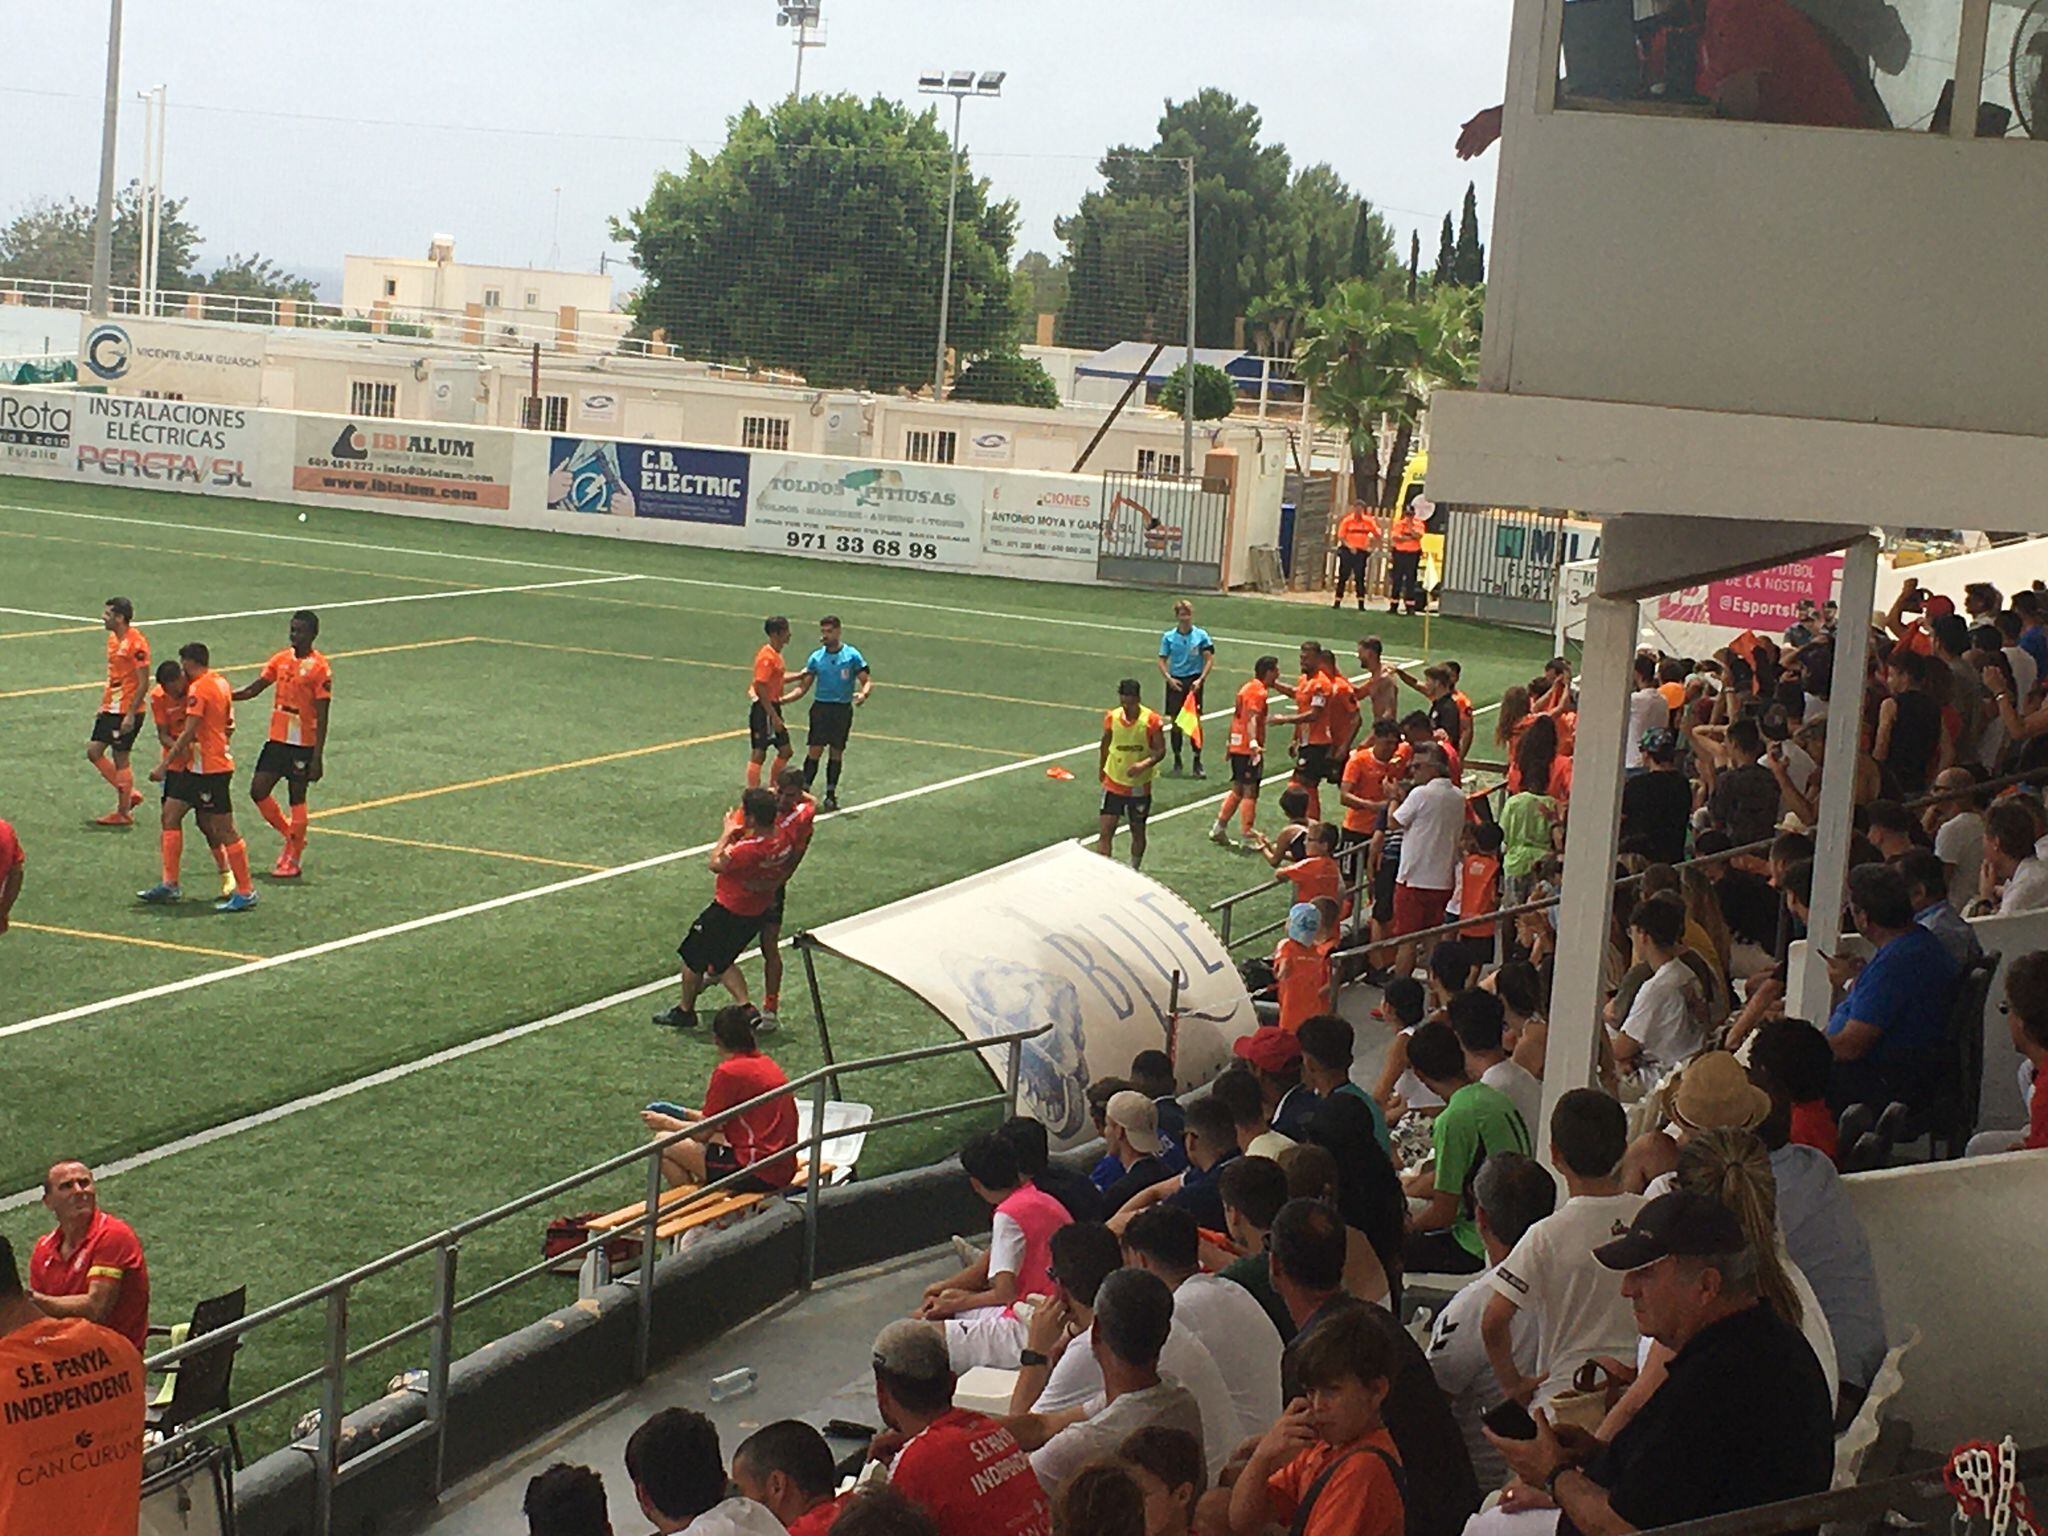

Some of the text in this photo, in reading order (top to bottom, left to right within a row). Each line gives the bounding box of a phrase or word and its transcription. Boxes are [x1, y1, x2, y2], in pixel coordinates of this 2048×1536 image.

[137, 347, 181, 361] VICENTE
[183, 351, 213, 364] JUAN
[215, 354, 260, 368] GUASCH
[1, 397, 71, 432] Rota
[89, 397, 245, 429] INSTALACIONES
[106, 419, 226, 450] ELÉCTRICAS
[372, 432, 475, 458] IBIALUM
[641, 449, 678, 472] C.B.
[640, 470, 742, 499] ELECTRIC
[772, 478, 957, 507] TOLDOS PITIUSAS
[992, 512, 1035, 524] ANTONIO
[1038, 516, 1066, 527] MOYA
[1069, 519, 1075, 529] Y
[786, 531, 938, 560] 971 33 68 98
[1765, 578, 1814, 595] NOSTRA
[16, 1346, 112, 1389] S.E. PENYA
[4, 1370, 133, 1425] INDEPENDENT
[17, 1457, 64, 1486] CAN
